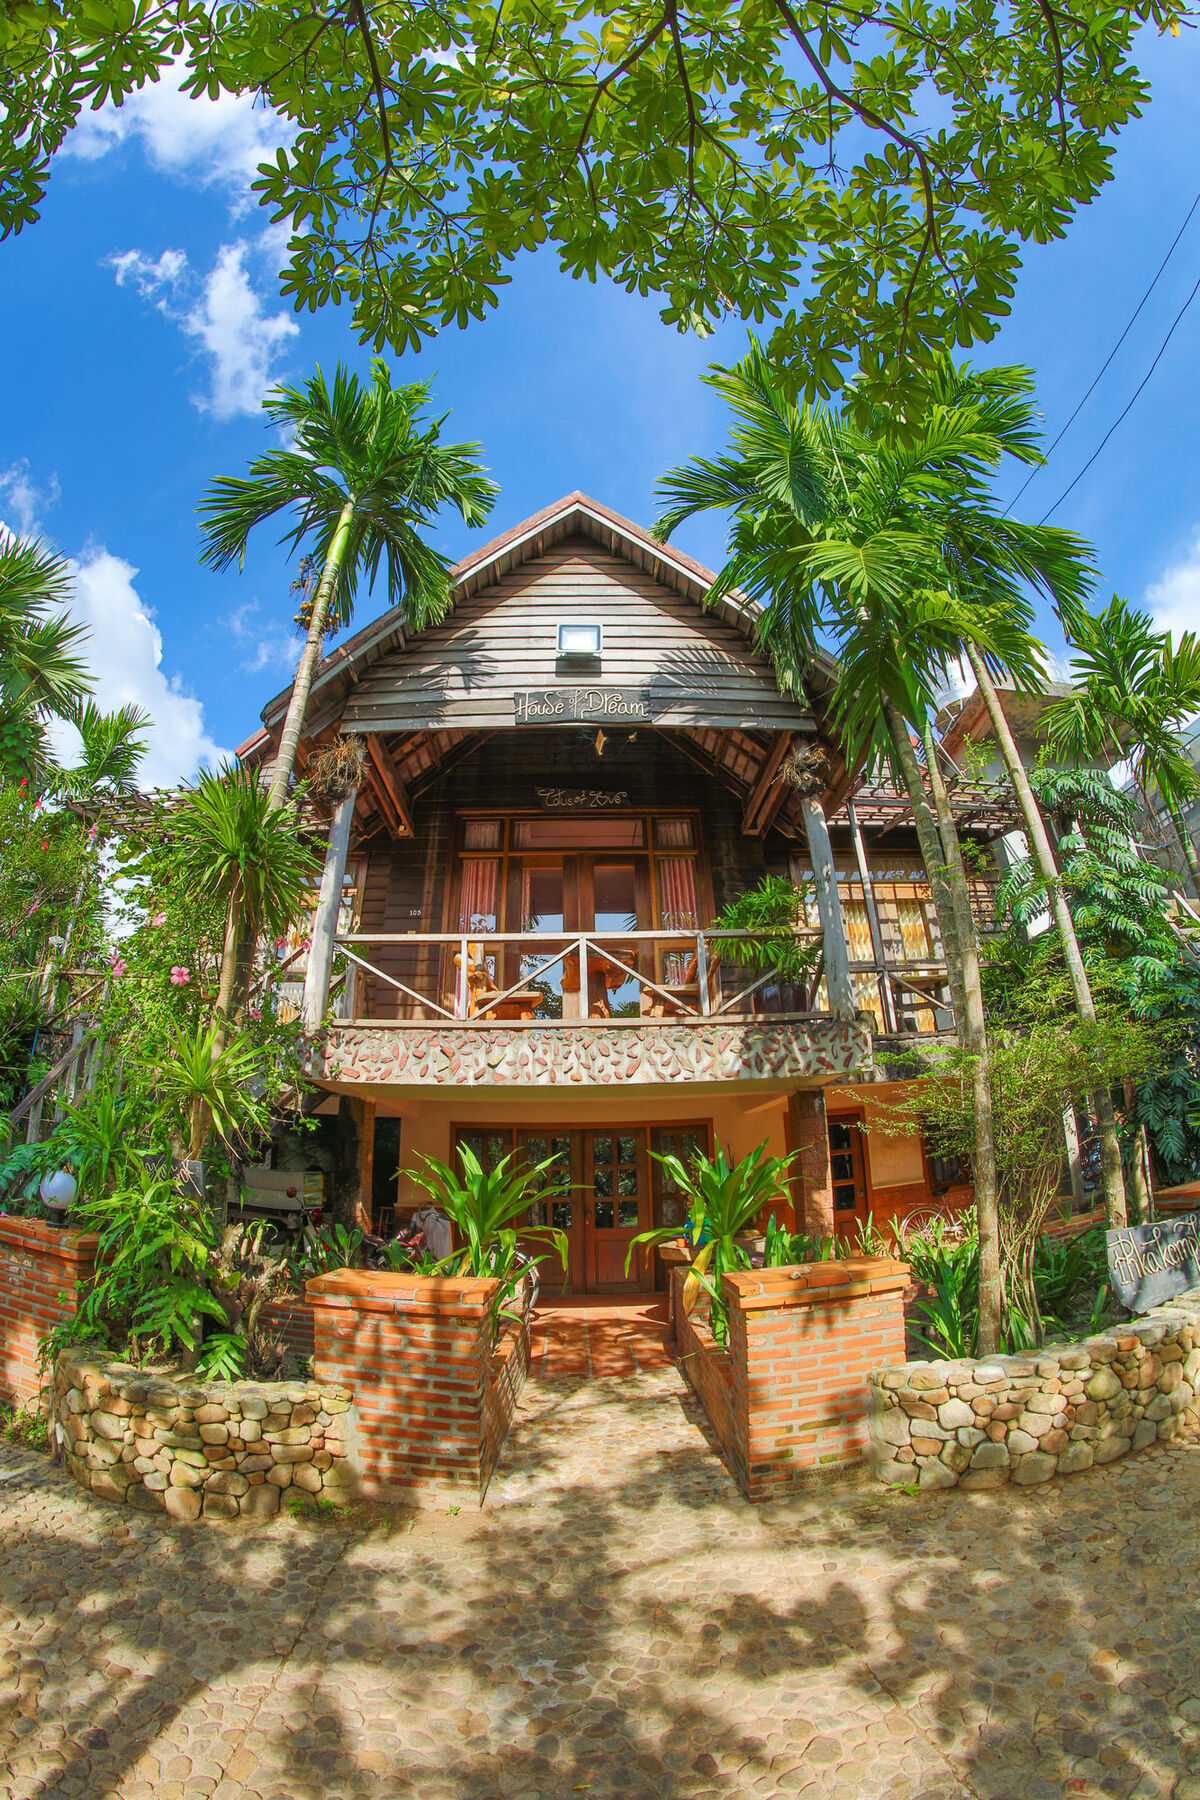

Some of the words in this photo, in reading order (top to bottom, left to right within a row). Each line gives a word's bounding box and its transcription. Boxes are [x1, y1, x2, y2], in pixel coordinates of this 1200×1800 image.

[514, 692, 564, 721] House
[563, 689, 586, 718] of
[580, 690, 649, 719] Dream
